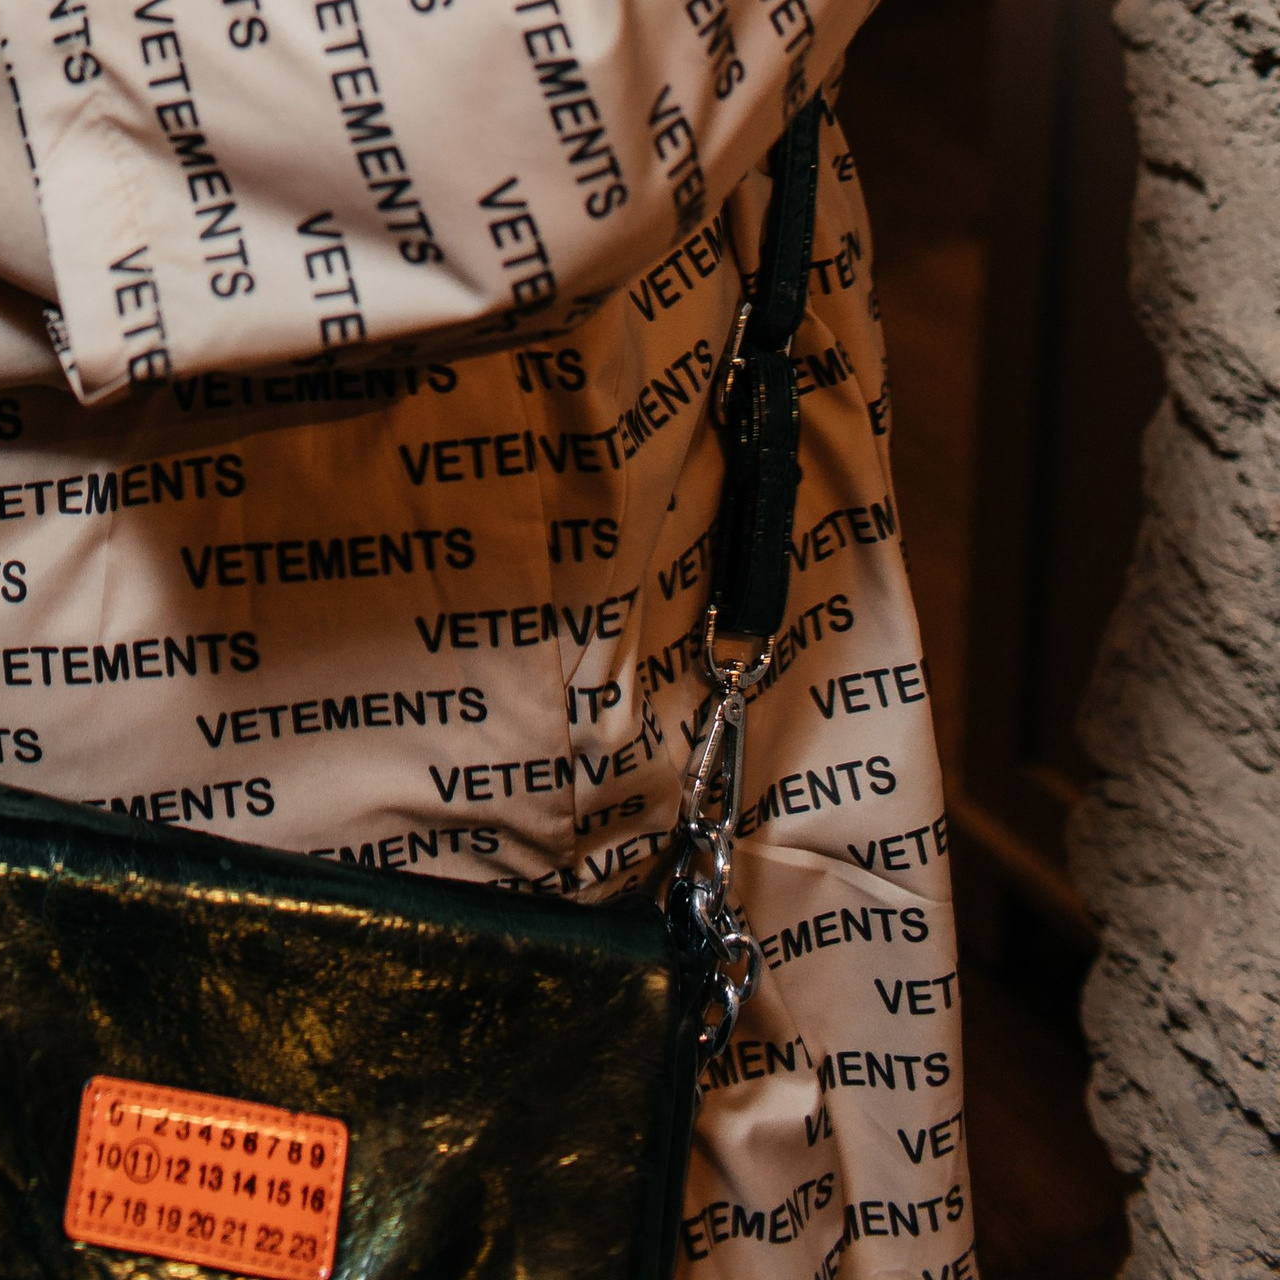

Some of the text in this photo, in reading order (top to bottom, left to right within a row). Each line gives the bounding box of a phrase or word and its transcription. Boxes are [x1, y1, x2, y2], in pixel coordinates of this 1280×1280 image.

[181, 527, 474, 589] VETEMENTS
[196, 687, 487, 748] VETEMENTS
[199, 1122, 212, 1145] 4
[221, 1127, 234, 1150] 5
[243, 1131, 257, 1155] 6
[266, 1134, 281, 1158] 7
[288, 1138, 302, 1164] 8
[310, 1144, 325, 1169] 9
[96, 1143, 324, 1213] 10 11 12 13 14 15 16
[88, 1191, 317, 1261] 17 18 19 20 21 22 23
